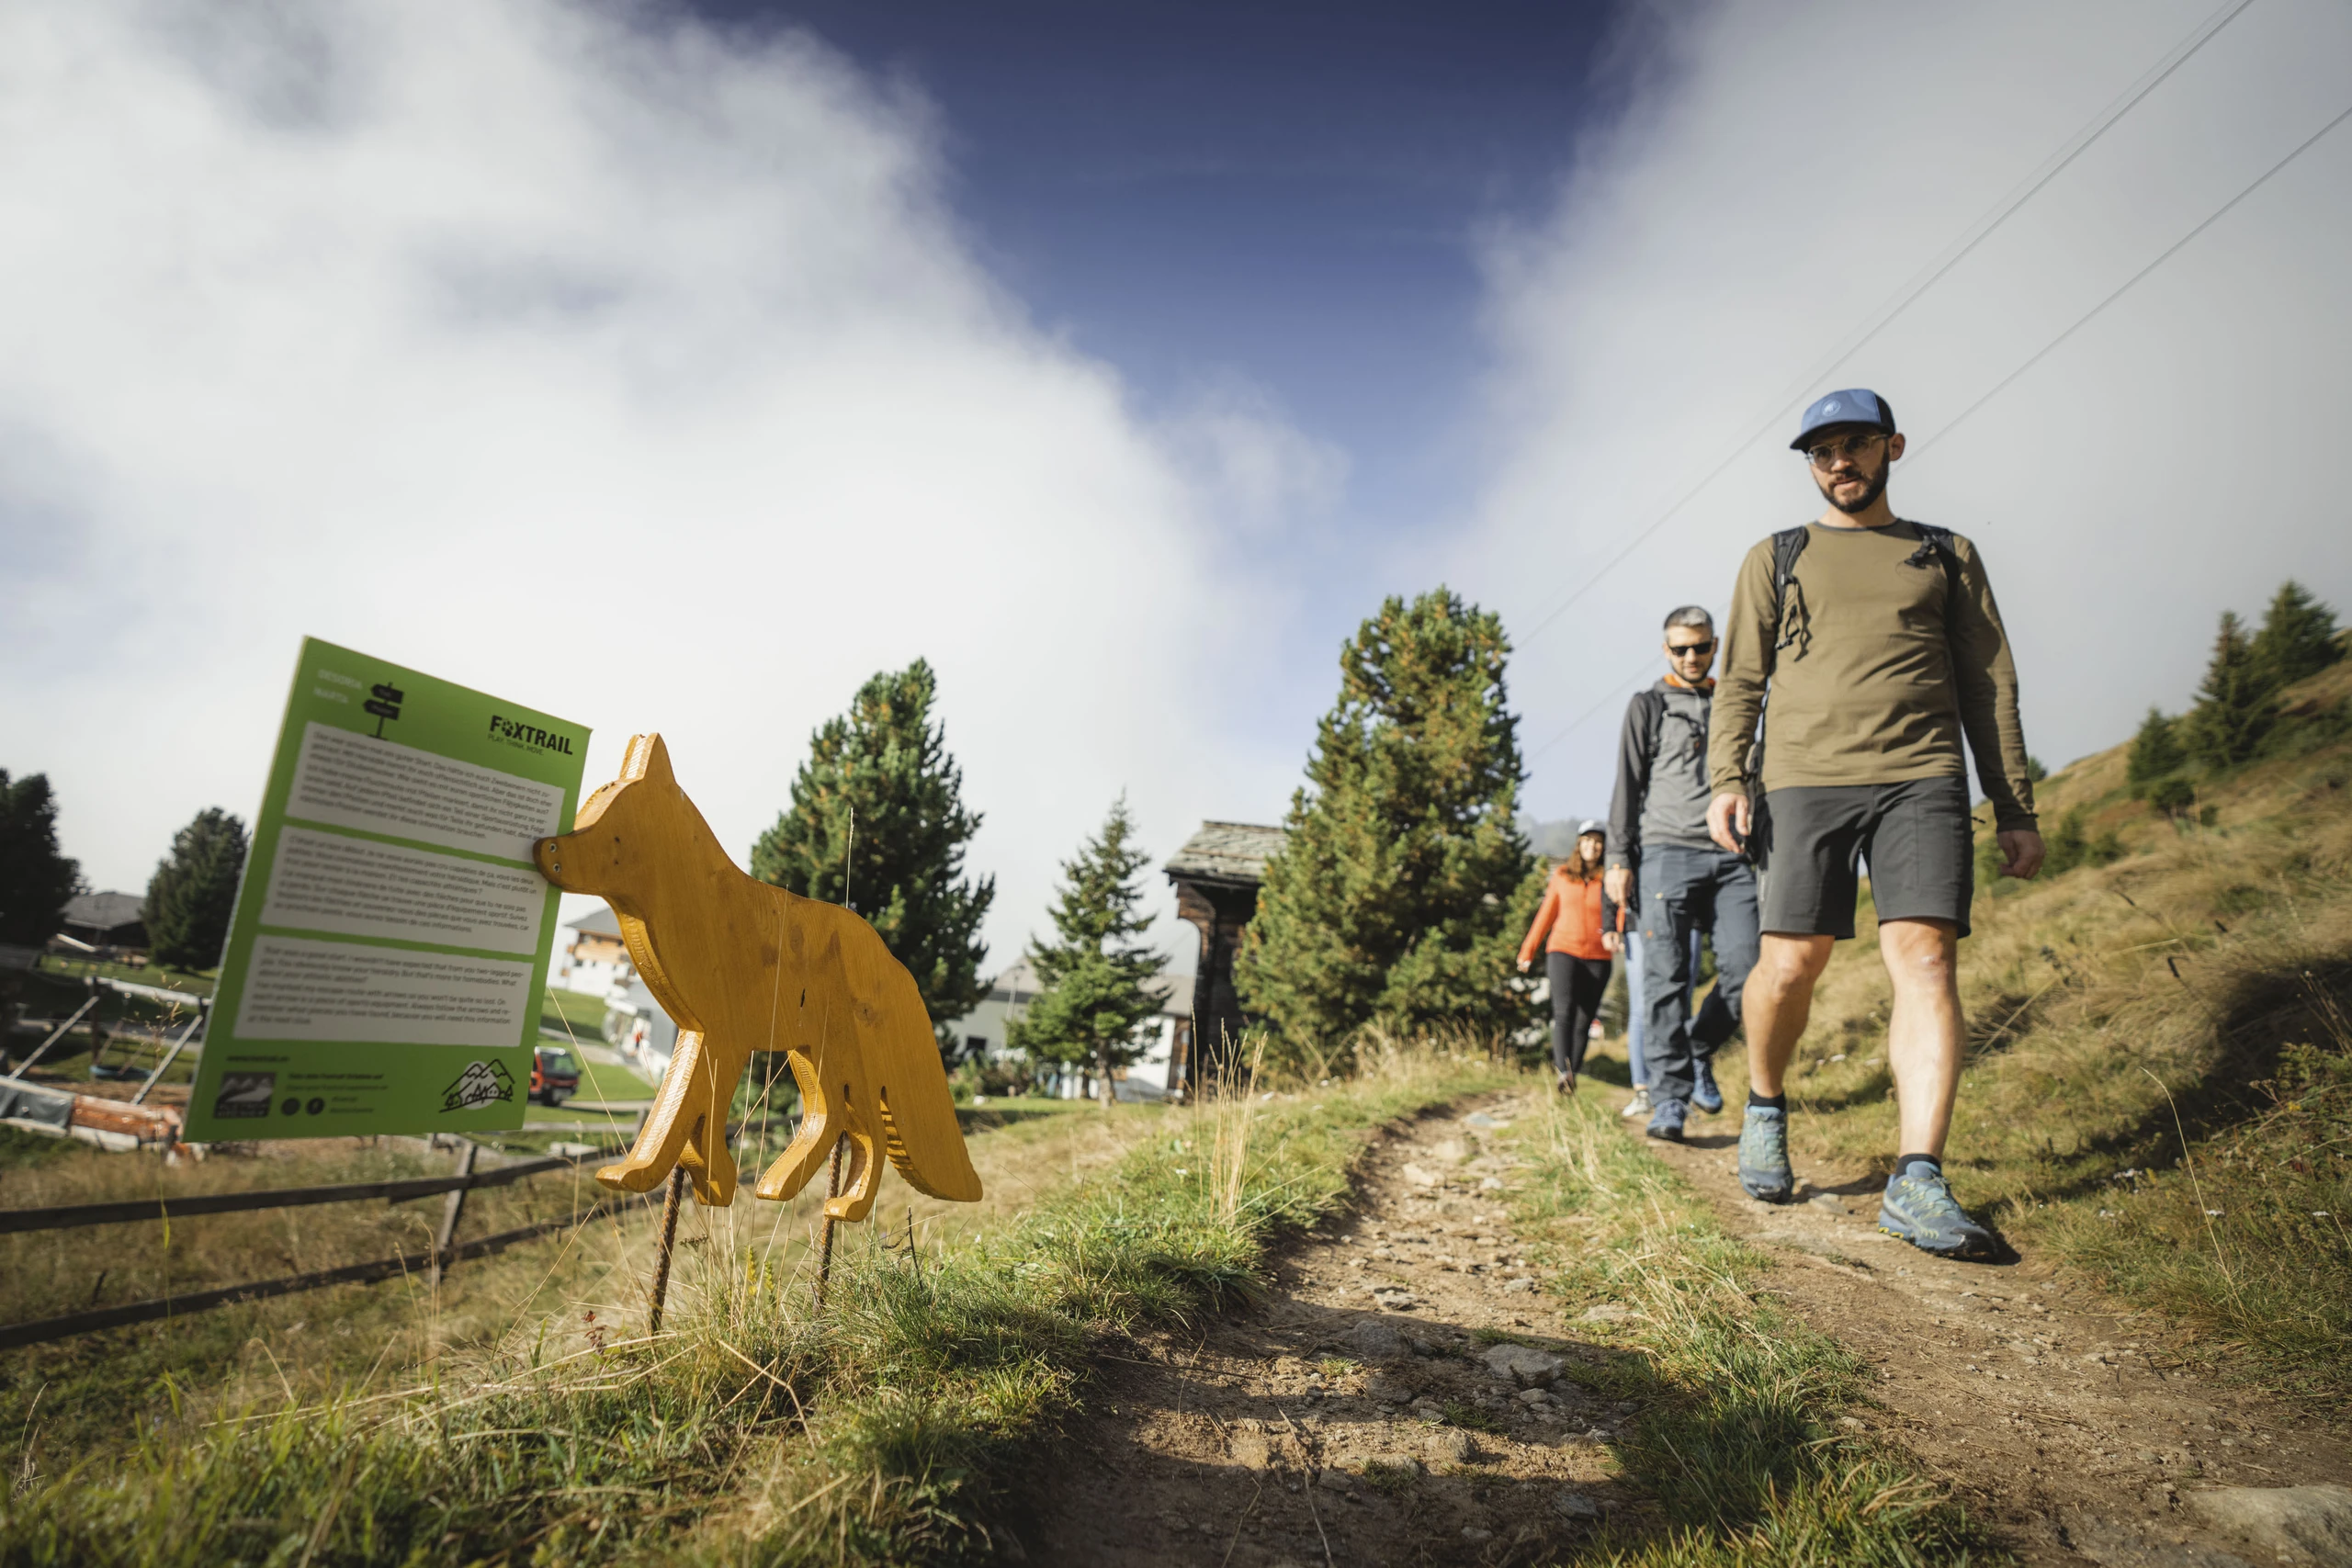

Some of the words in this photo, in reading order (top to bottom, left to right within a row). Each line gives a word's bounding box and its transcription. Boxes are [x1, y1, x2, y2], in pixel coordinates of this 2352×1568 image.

[489, 714, 574, 755] FOXTRAIL
[539, 798, 552, 807] eher
[535, 806, 548, 815] aus?
